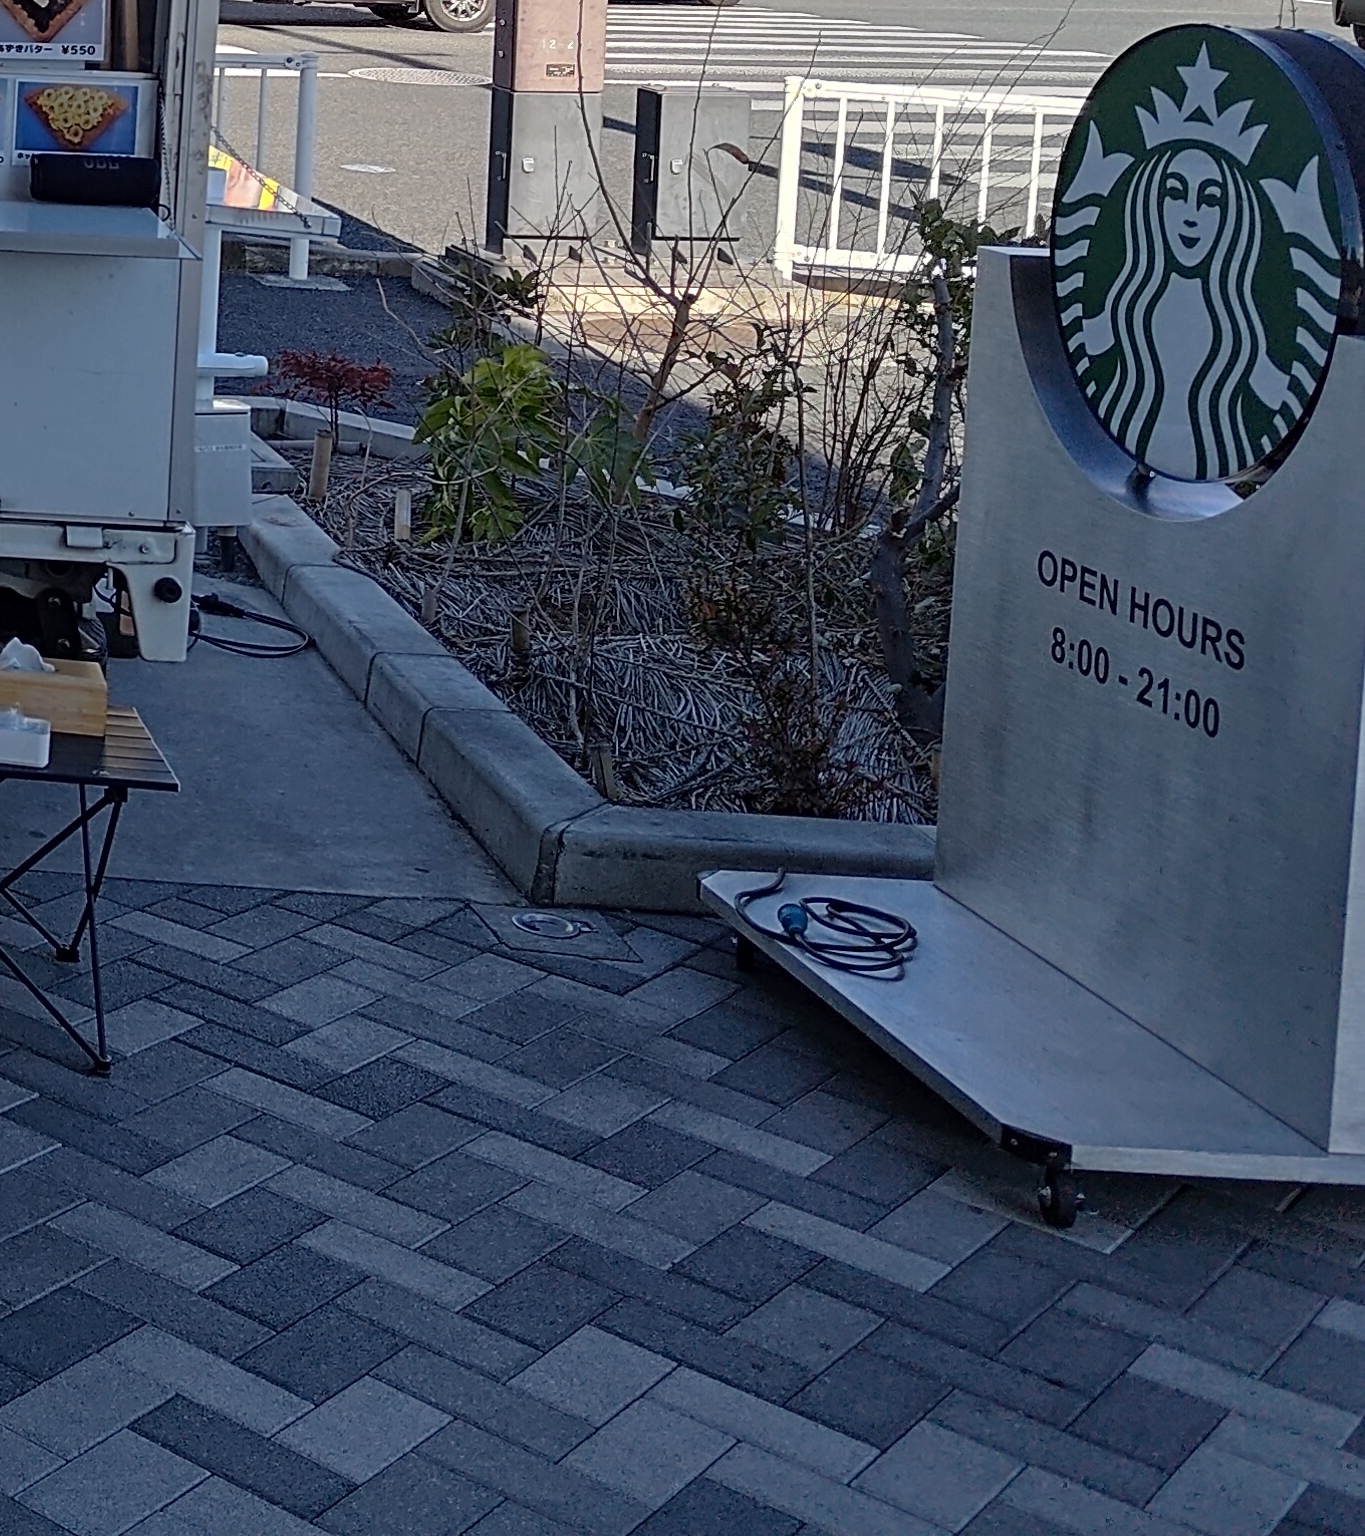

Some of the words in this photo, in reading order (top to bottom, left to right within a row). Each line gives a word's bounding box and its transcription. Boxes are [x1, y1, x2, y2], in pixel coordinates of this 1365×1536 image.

[61, 45, 95, 56] ¥550
[1038, 550, 1118, 616] OPEN
[1129, 586, 1245, 670] HOURS
[1051, 627, 1109, 684] 8:00
[1136, 667, 1219, 738] 21:00
